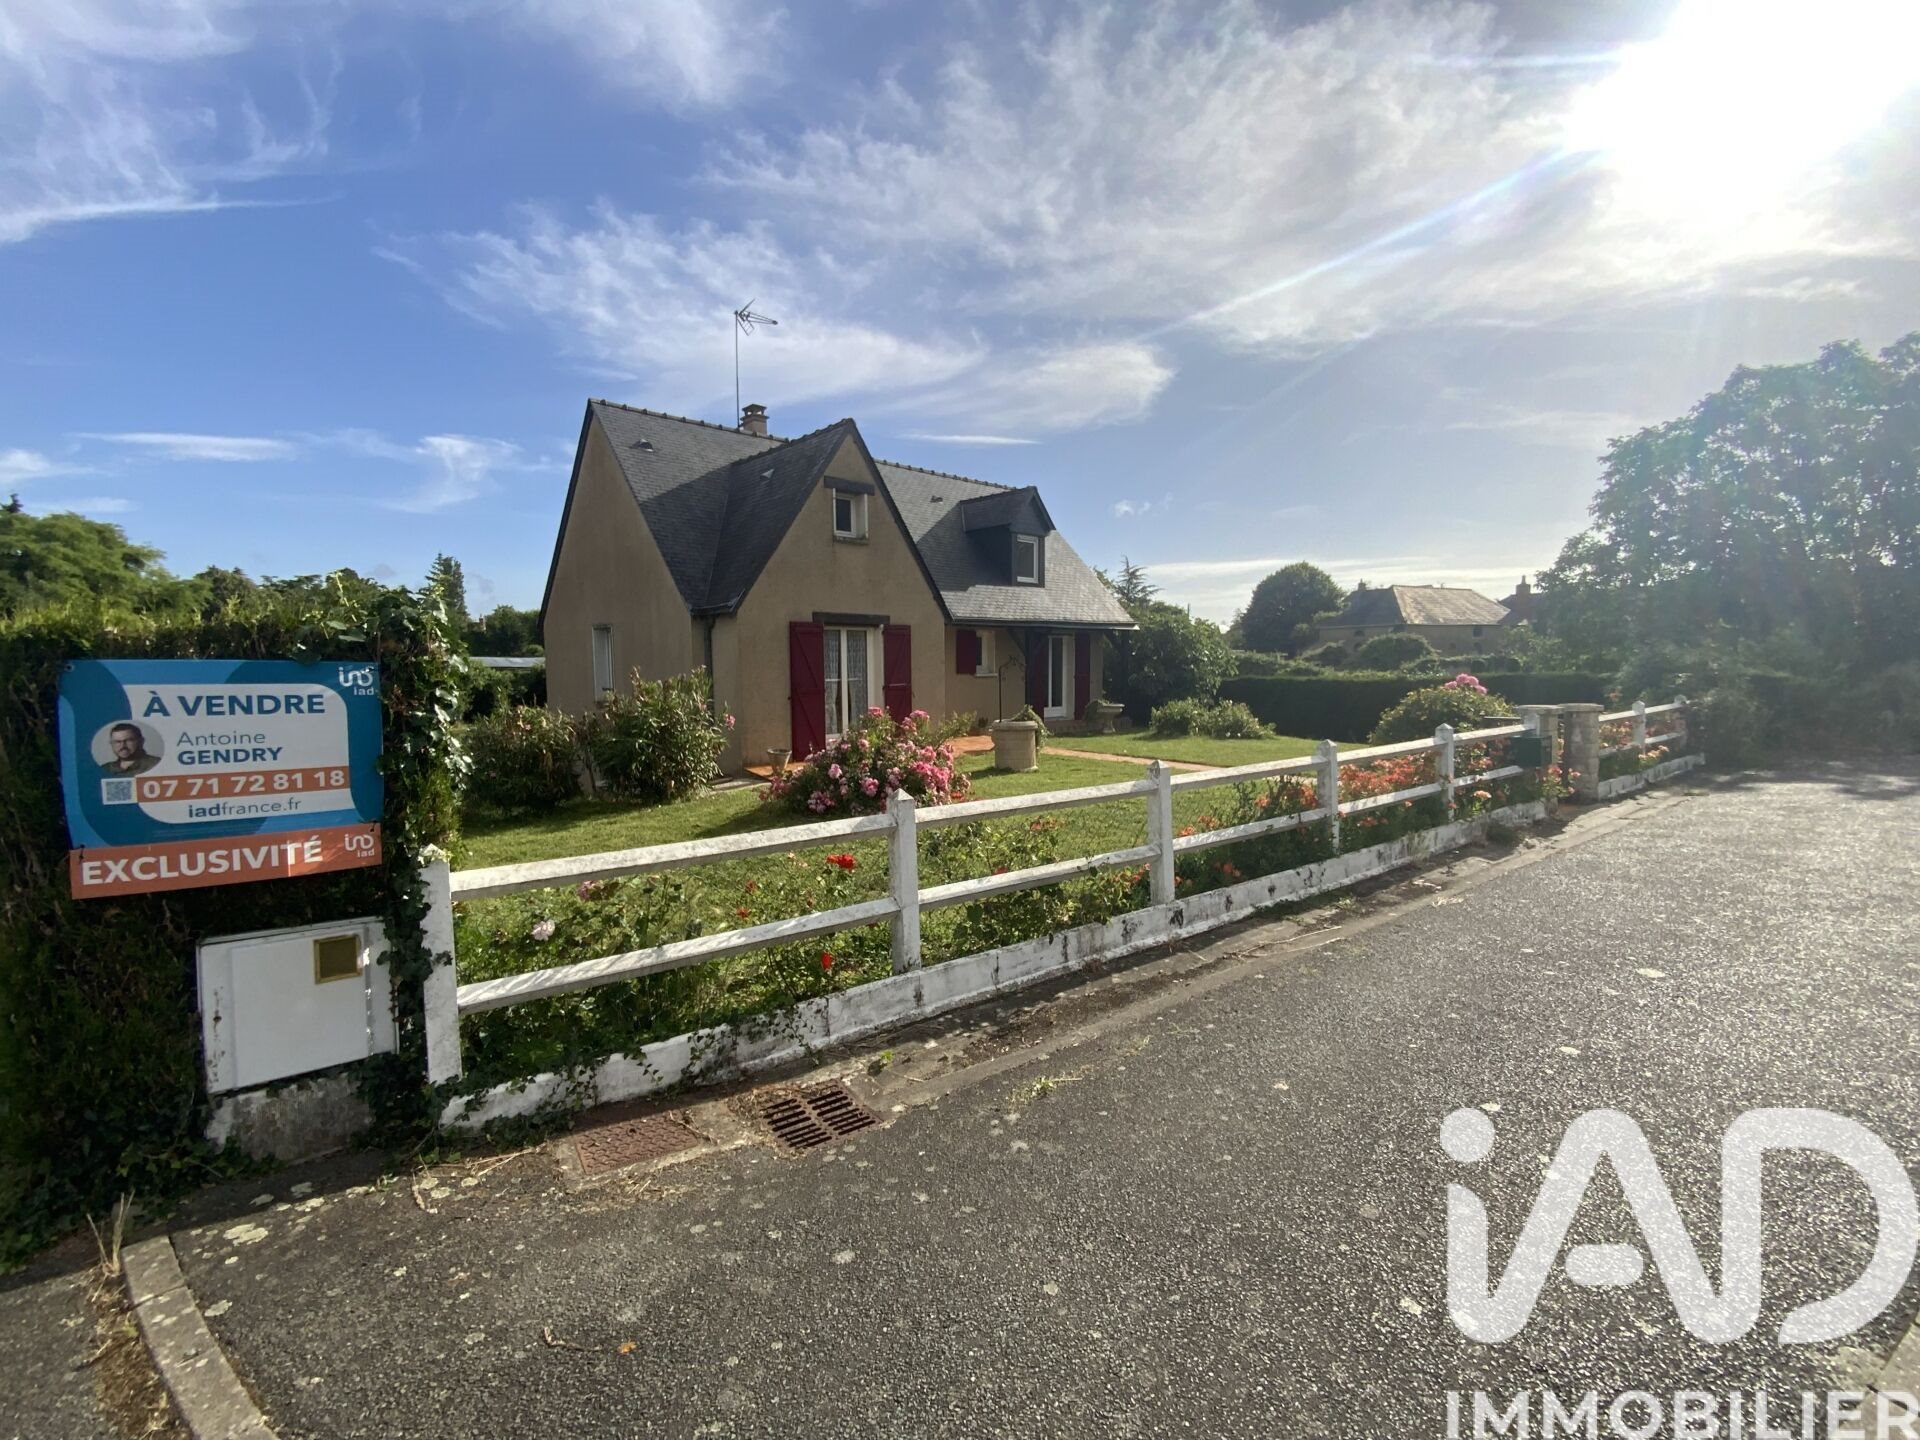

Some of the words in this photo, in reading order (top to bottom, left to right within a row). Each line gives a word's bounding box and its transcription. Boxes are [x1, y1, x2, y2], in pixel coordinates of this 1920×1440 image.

[353, 686, 374, 695] iad
[143, 691, 171, 717] À
[178, 694, 326, 716] VENDRE
[176, 731, 266, 747] Antoine
[177, 747, 282, 765] GENDRY
[143, 780, 178, 799] 07
[187, 776, 220, 795] 71
[231, 774, 266, 793] 72
[273, 772, 304, 791] 81
[314, 770, 346, 787] 18
[188, 797, 302, 819] iadfrance.fr
[82, 835, 323, 885] EXCLUSIVITÉ
[357, 848, 375, 858] iad
